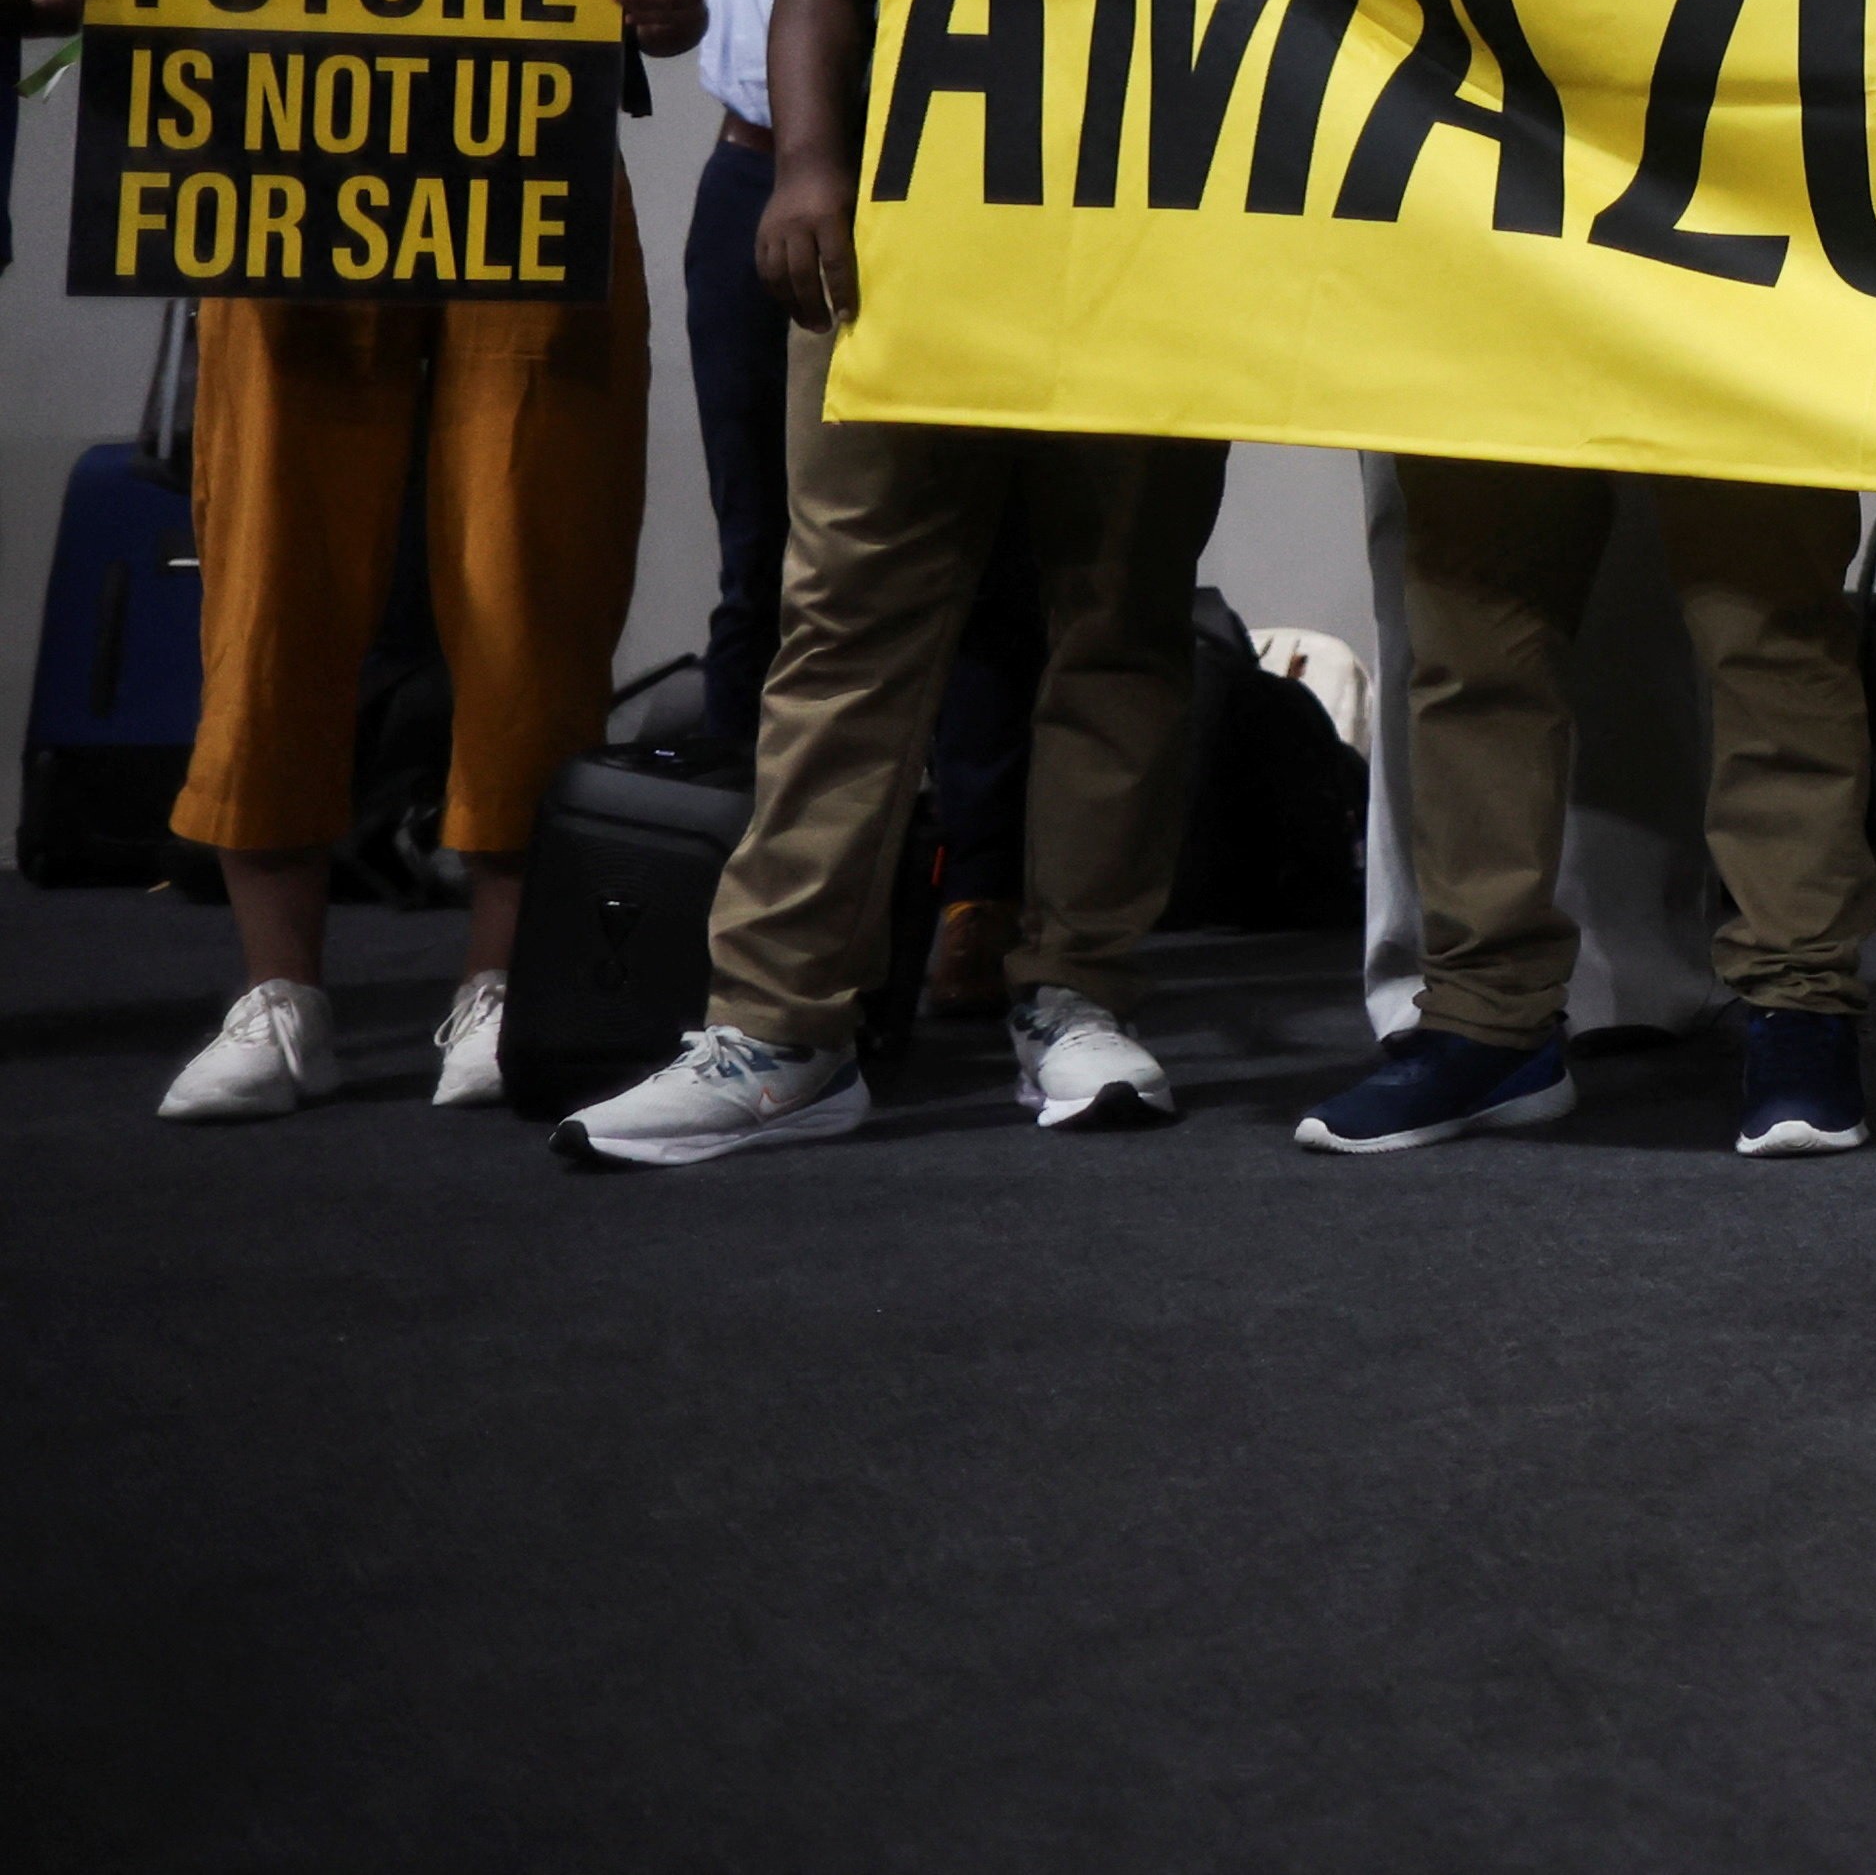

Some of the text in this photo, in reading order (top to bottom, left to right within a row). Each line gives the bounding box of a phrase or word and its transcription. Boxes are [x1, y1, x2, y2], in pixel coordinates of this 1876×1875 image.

[128, 48, 573, 158] IS NOT UP
[115, 171, 568, 282] FOR SALE
